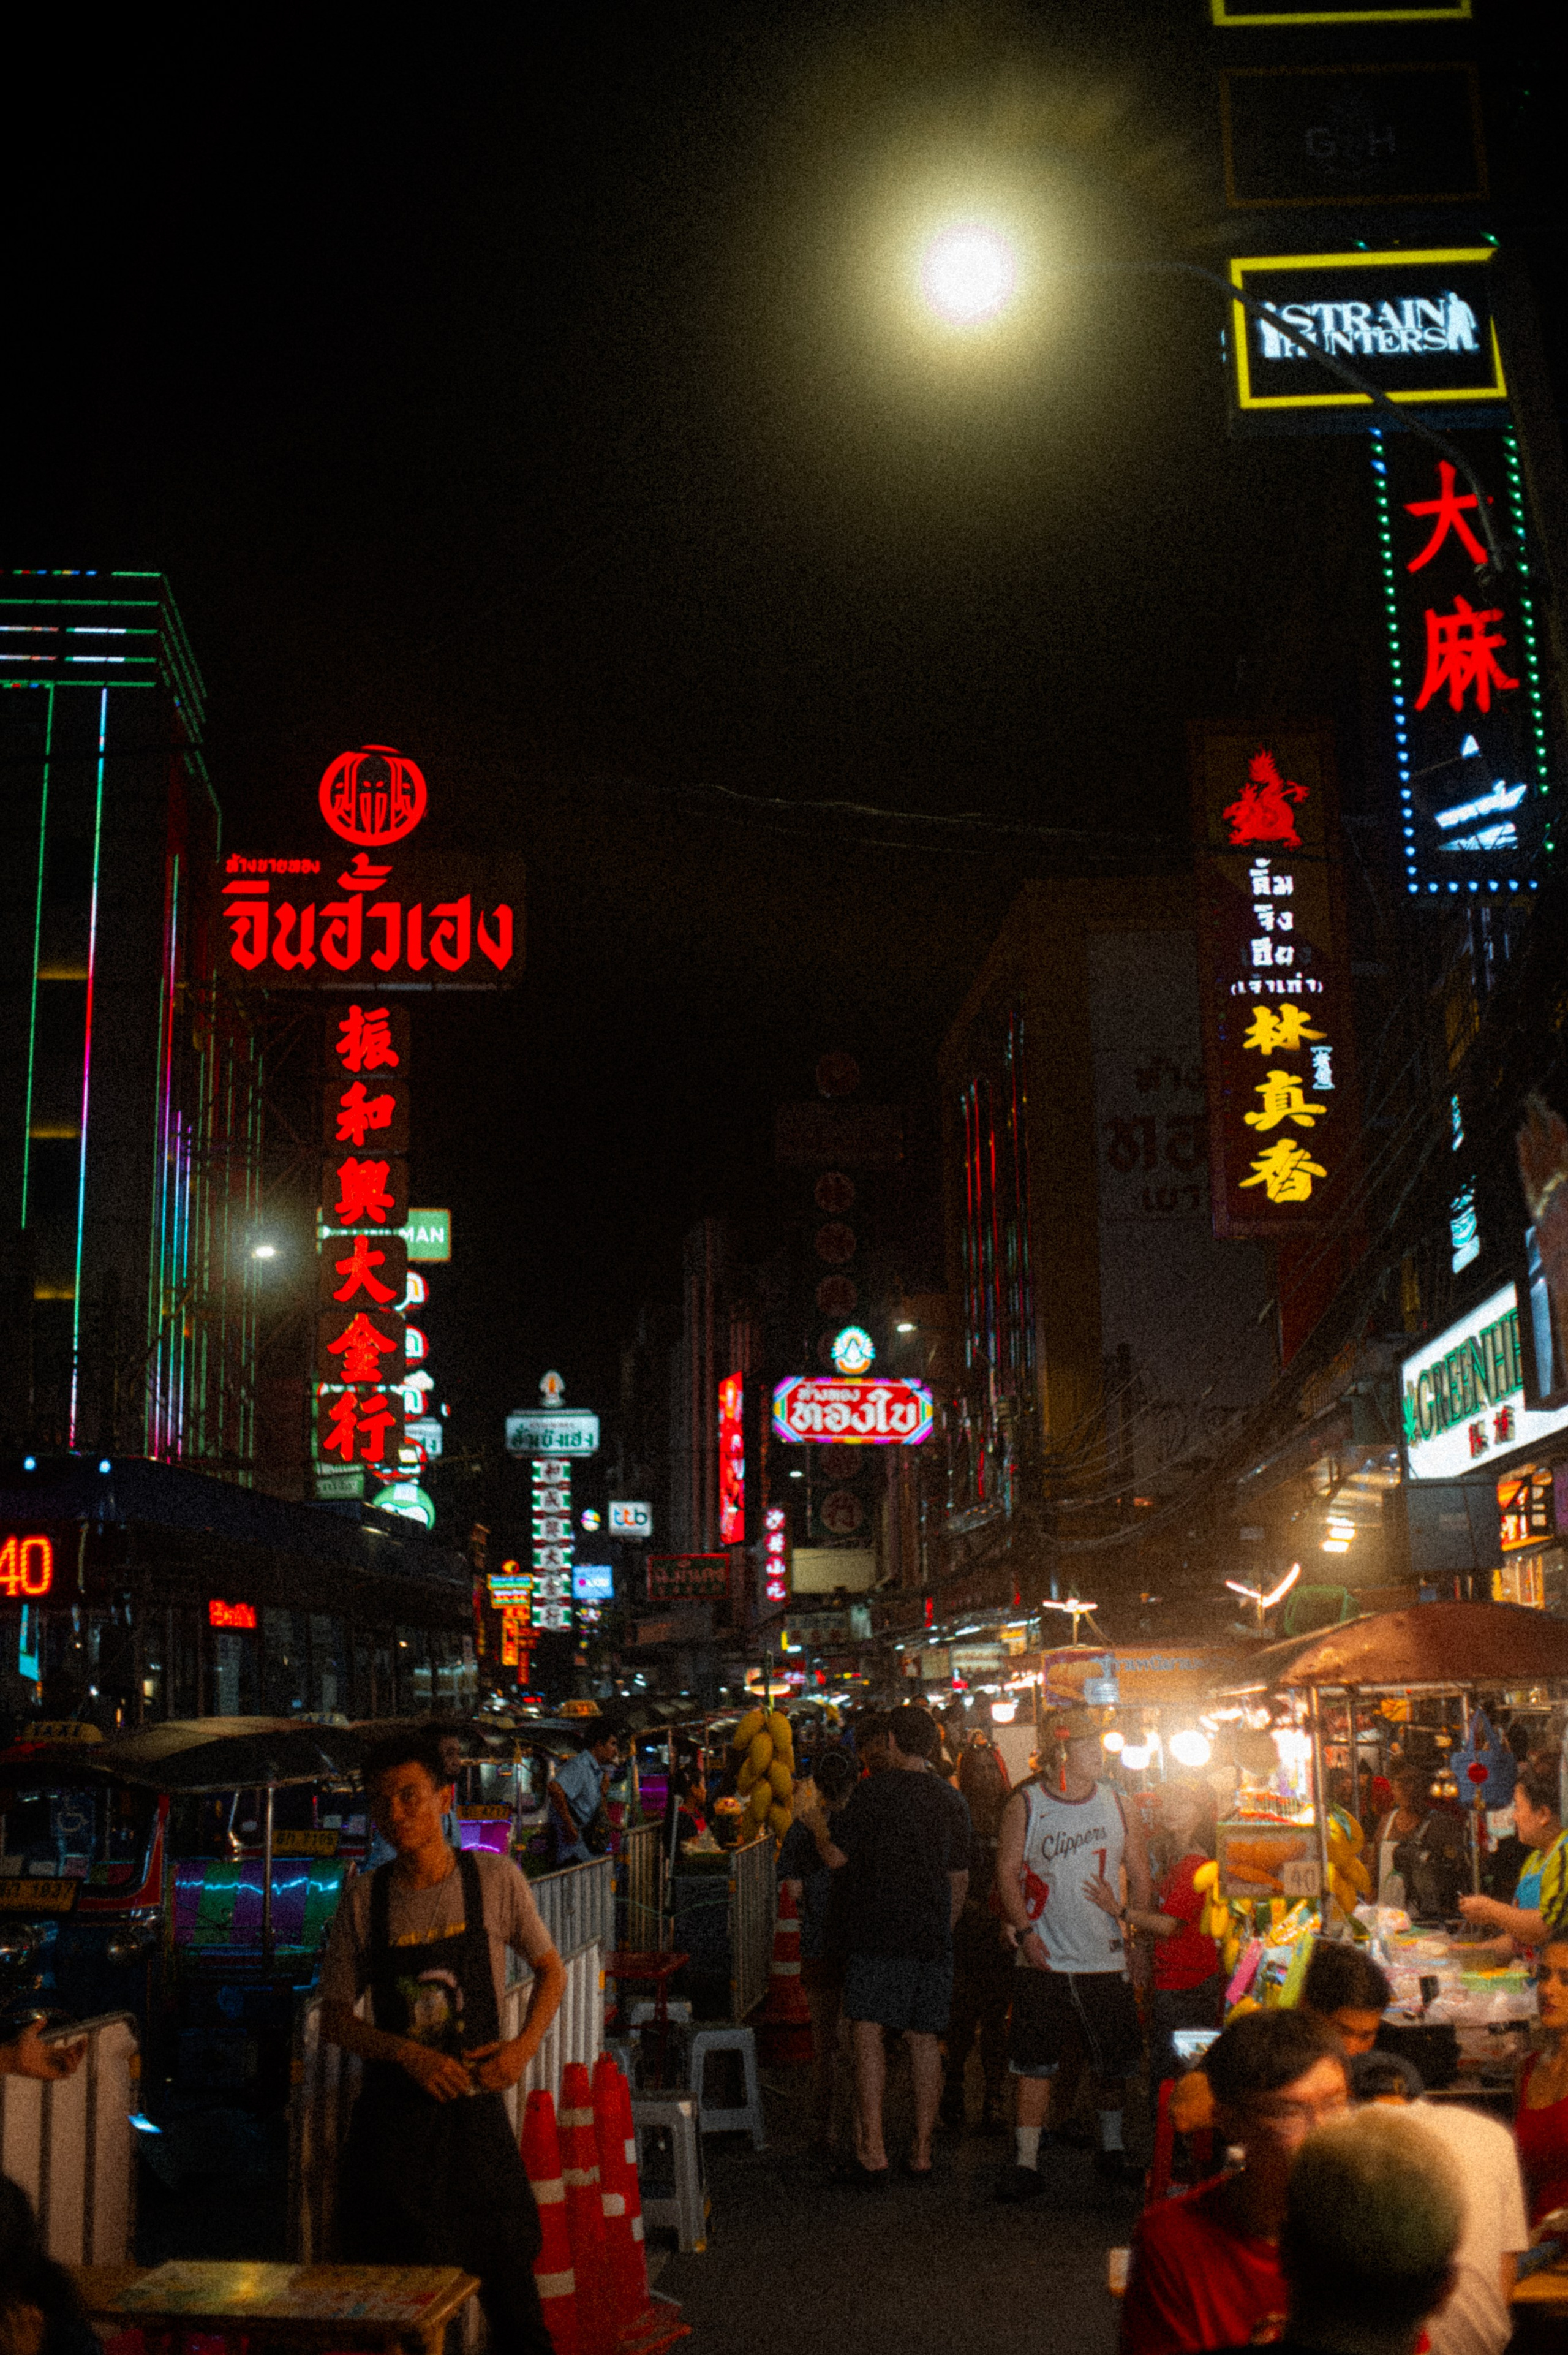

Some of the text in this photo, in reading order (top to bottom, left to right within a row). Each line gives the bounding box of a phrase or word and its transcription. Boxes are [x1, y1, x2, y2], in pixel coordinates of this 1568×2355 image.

[1281, 298, 1446, 333] STRAIN
[1286, 328, 1448, 357] NTERS
[1403, 460, 1519, 712] 大麻
[1238, 1003, 1327, 1203] 林真香
[323, 1004, 399, 1462] 振和興大金行
[614, 1508, 647, 1526] ttb
[0, 1535, 53, 1596] 40
[1042, 1825, 1107, 1861] Clippers
